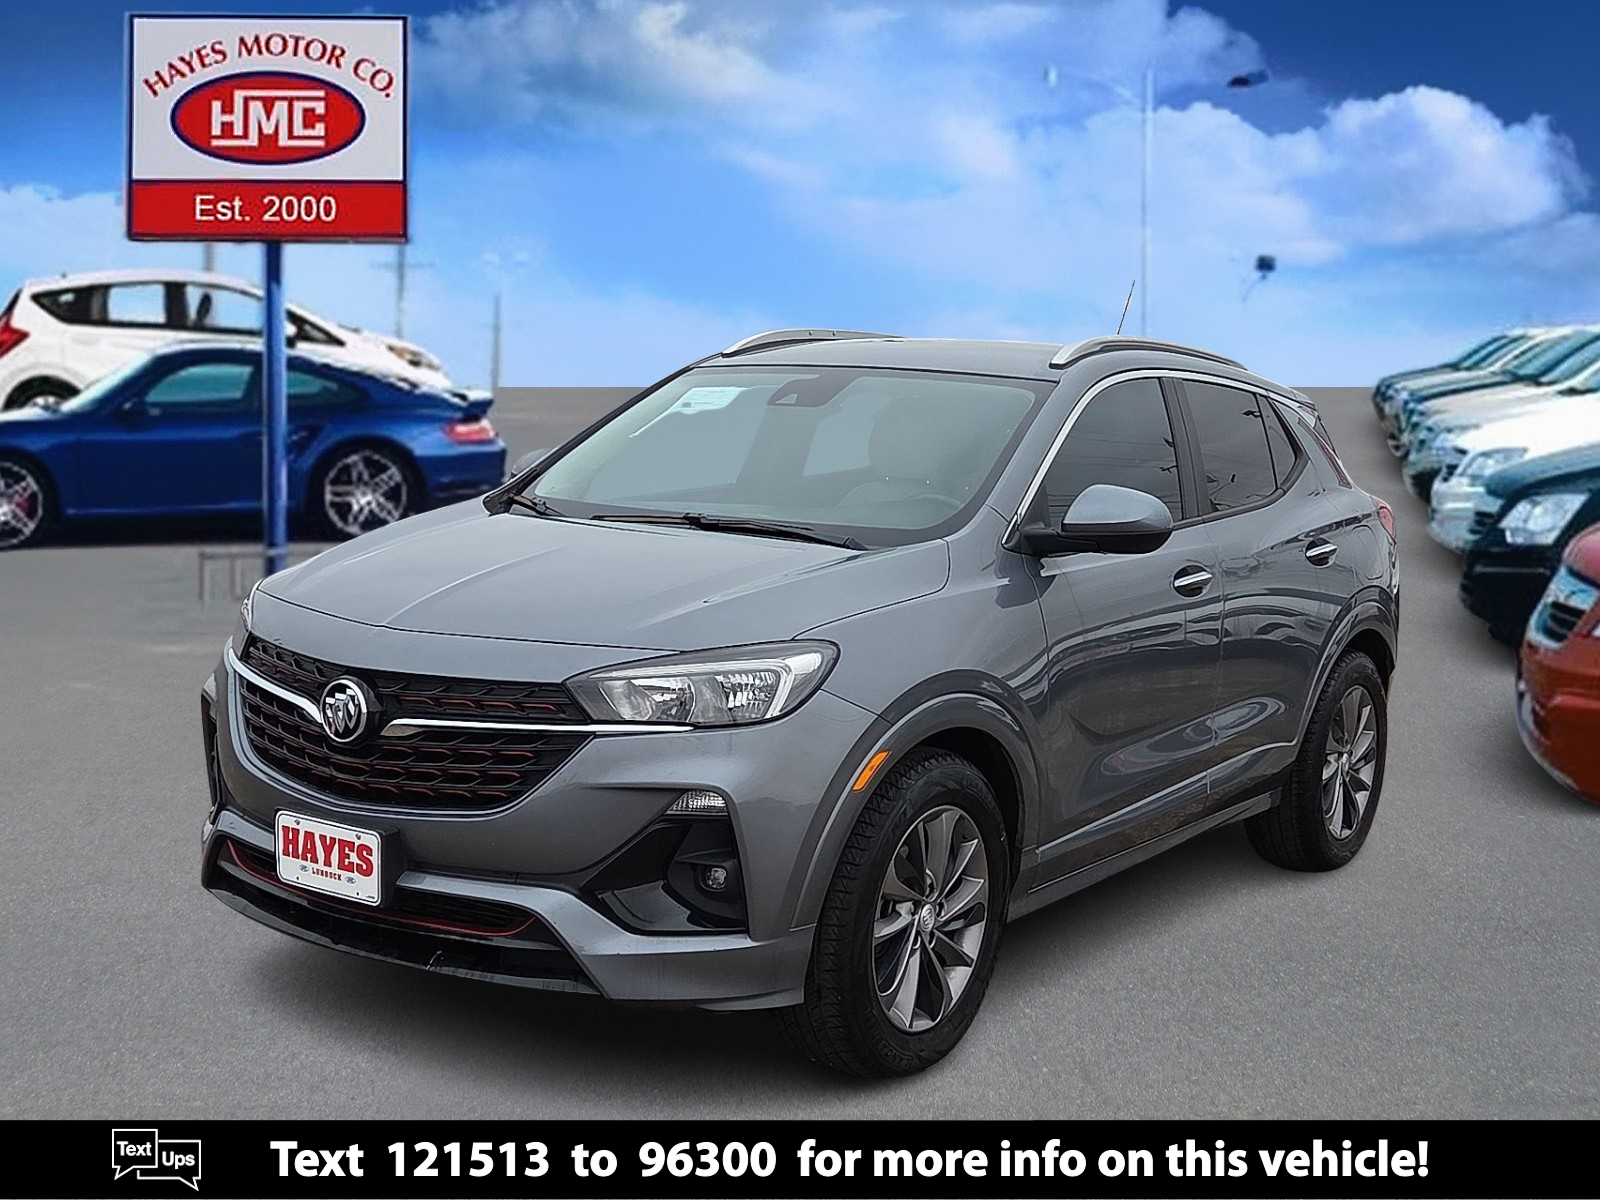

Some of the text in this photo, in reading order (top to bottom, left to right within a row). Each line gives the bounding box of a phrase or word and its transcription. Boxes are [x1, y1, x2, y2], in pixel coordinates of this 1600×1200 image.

[143, 33, 395, 98] HAYES MOTOR CO.
[211, 89, 325, 147] HMC
[195, 194, 336, 222] Est. 2000
[281, 824, 374, 878] HAYES
